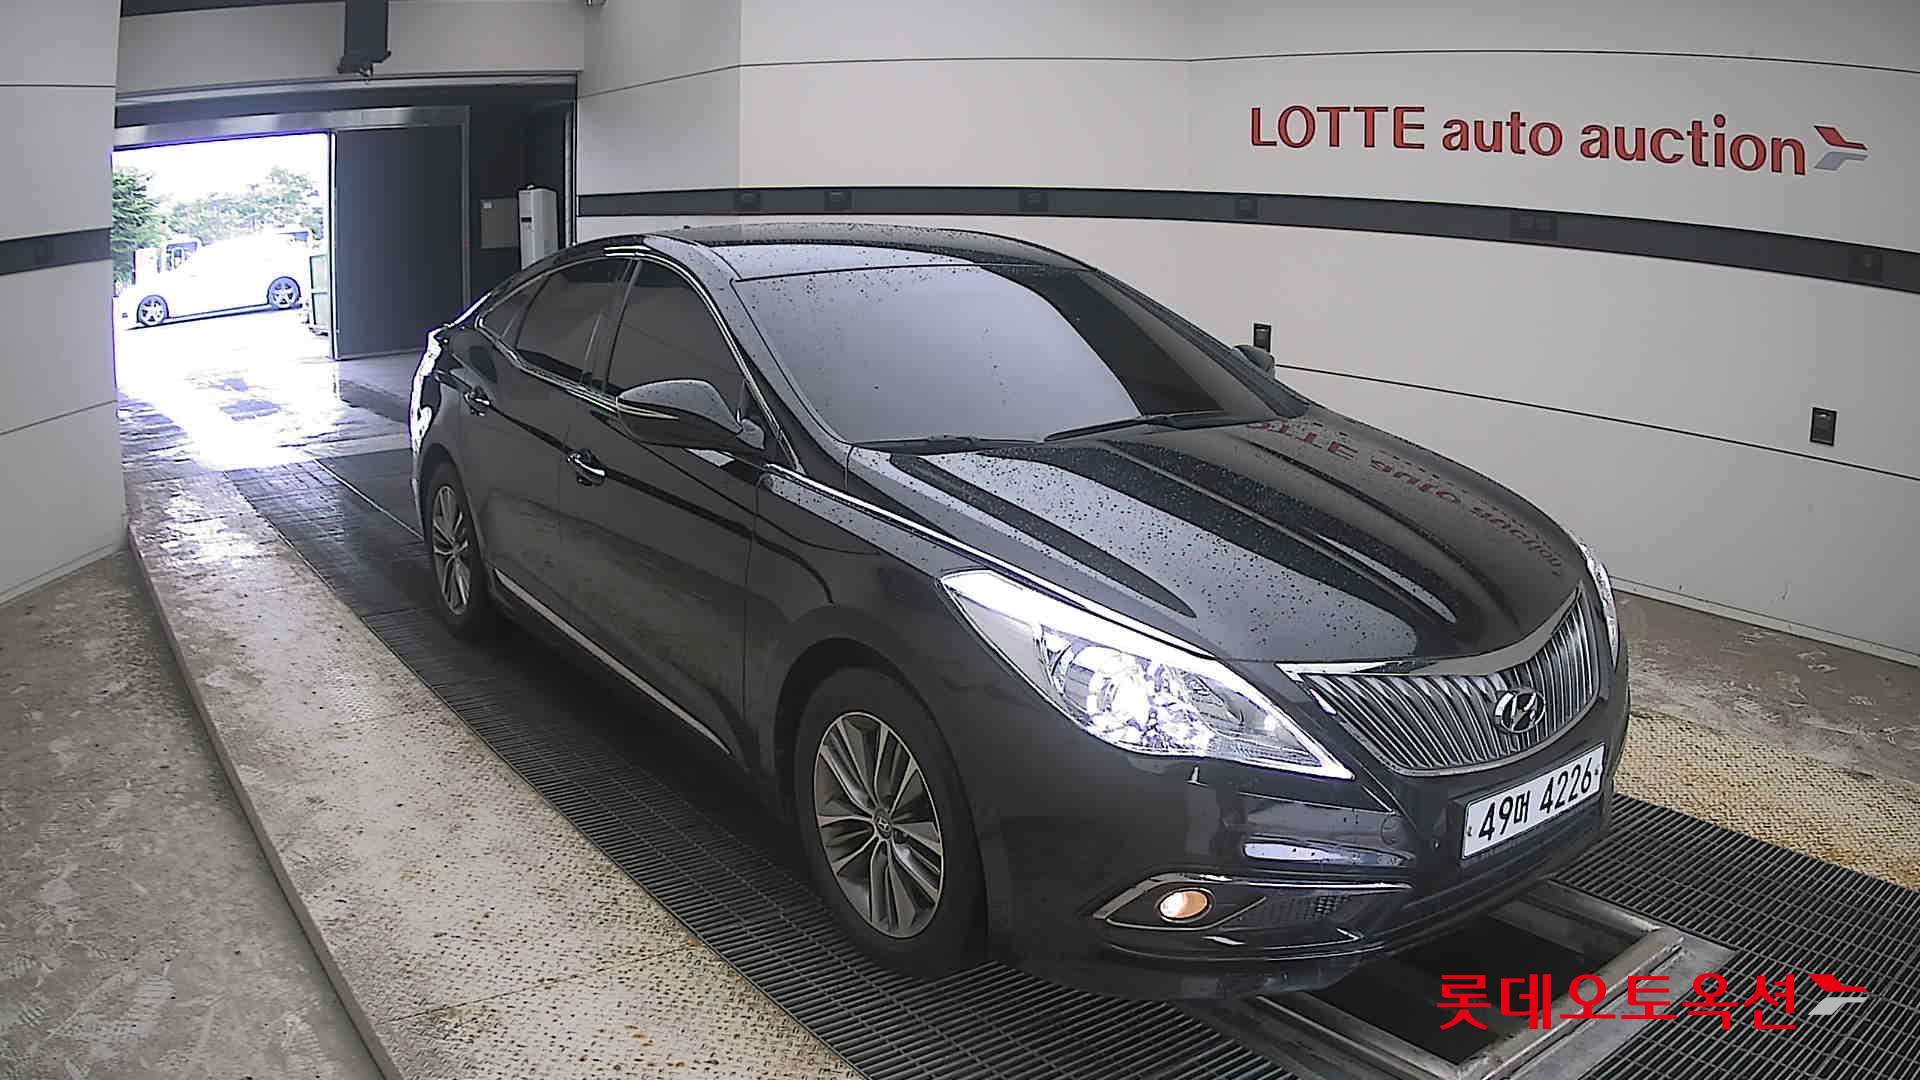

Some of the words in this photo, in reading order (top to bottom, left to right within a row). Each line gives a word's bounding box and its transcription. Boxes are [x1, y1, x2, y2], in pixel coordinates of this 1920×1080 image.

[1250, 104, 1426, 150] LOTTE
[1442, 112, 1564, 158] auto
[1580, 115, 1807, 176] auction
[1478, 790, 1531, 841] 49머
[1539, 757, 1593, 814] 4226
